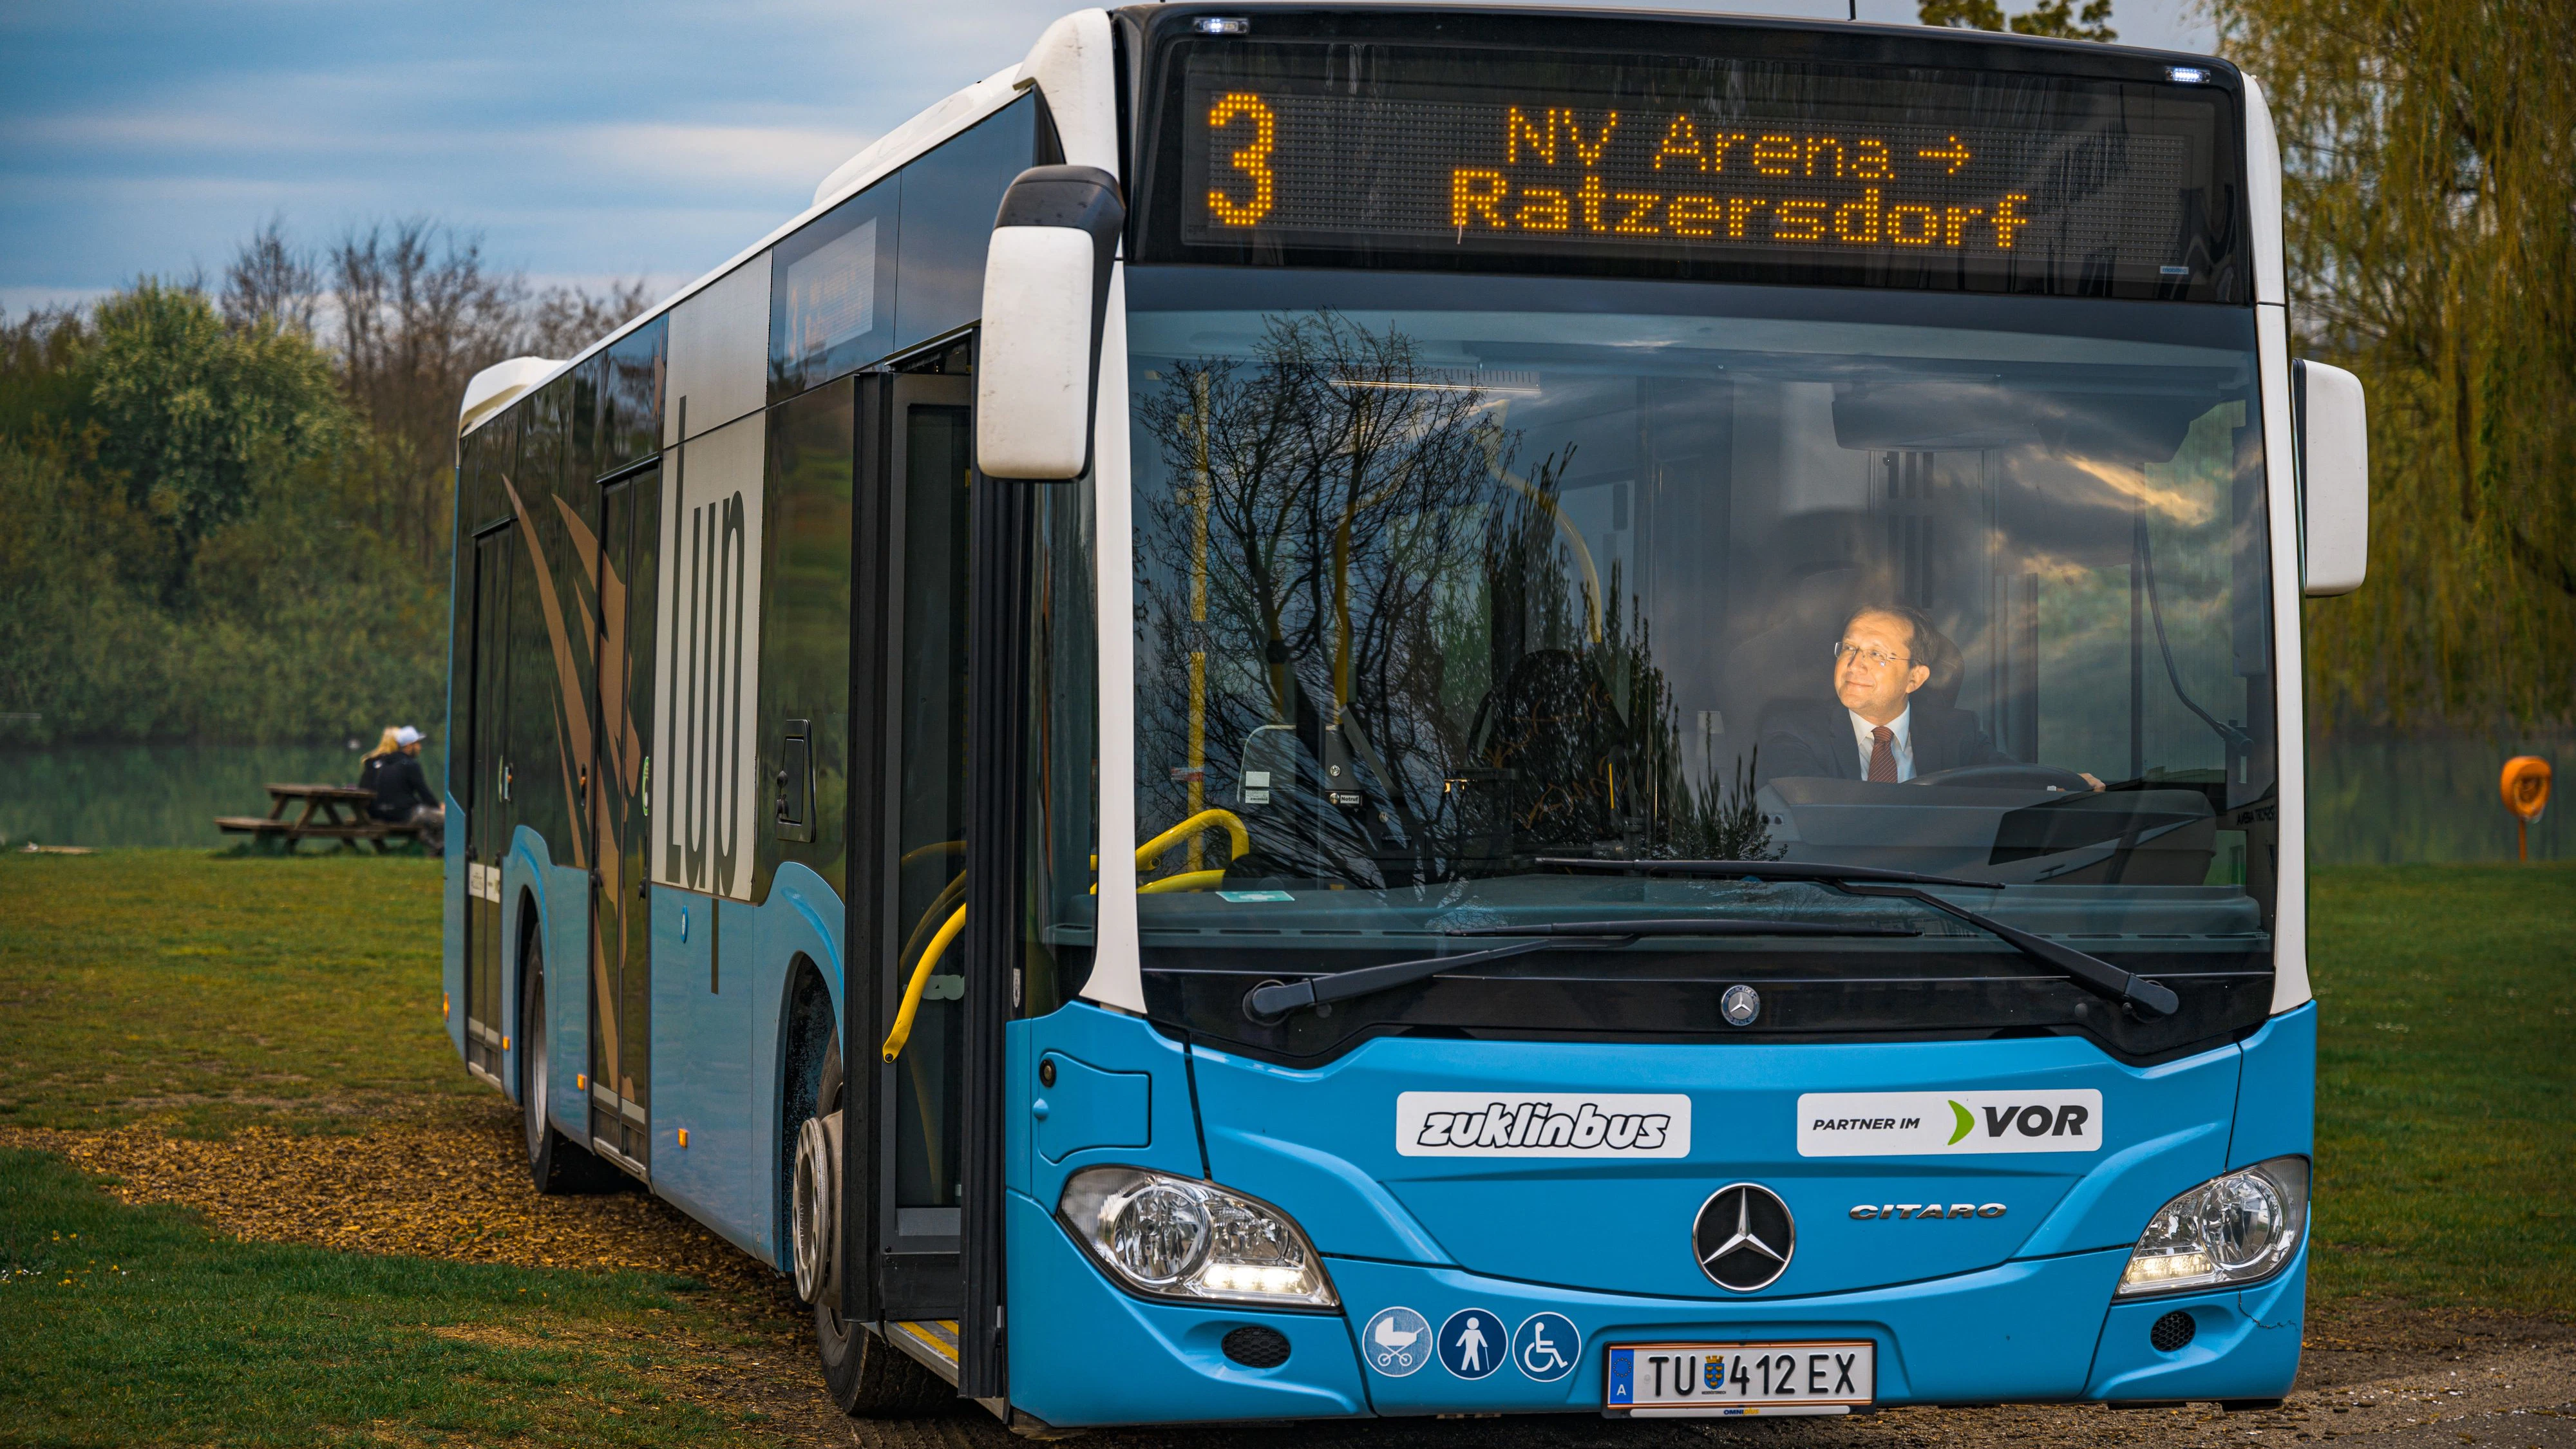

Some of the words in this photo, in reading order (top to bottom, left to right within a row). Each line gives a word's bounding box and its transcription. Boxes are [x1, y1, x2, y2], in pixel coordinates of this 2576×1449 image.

[1209, 93, 1274, 226] 3
[1510, 107, 1617, 166] NV
[1655, 115, 1895, 180] Arena
[1454, 170, 2028, 248] Ratzersdorf
[1417, 1102, 1671, 1150] zuklinbus
[1812, 1119, 1896, 1131] PARTNER
[1899, 1117, 1920, 1130] IM
[1981, 1105, 2089, 1137] VOR
[1849, 1203, 2007, 1220] CITARO
[1616, 1383, 1627, 1396] A
[1649, 1356, 1696, 1397] TU
[1730, 1354, 1797, 1396] 412
[1809, 1353, 1856, 1396] EX
[1723, 1407, 1759, 1417] OMNIplus
